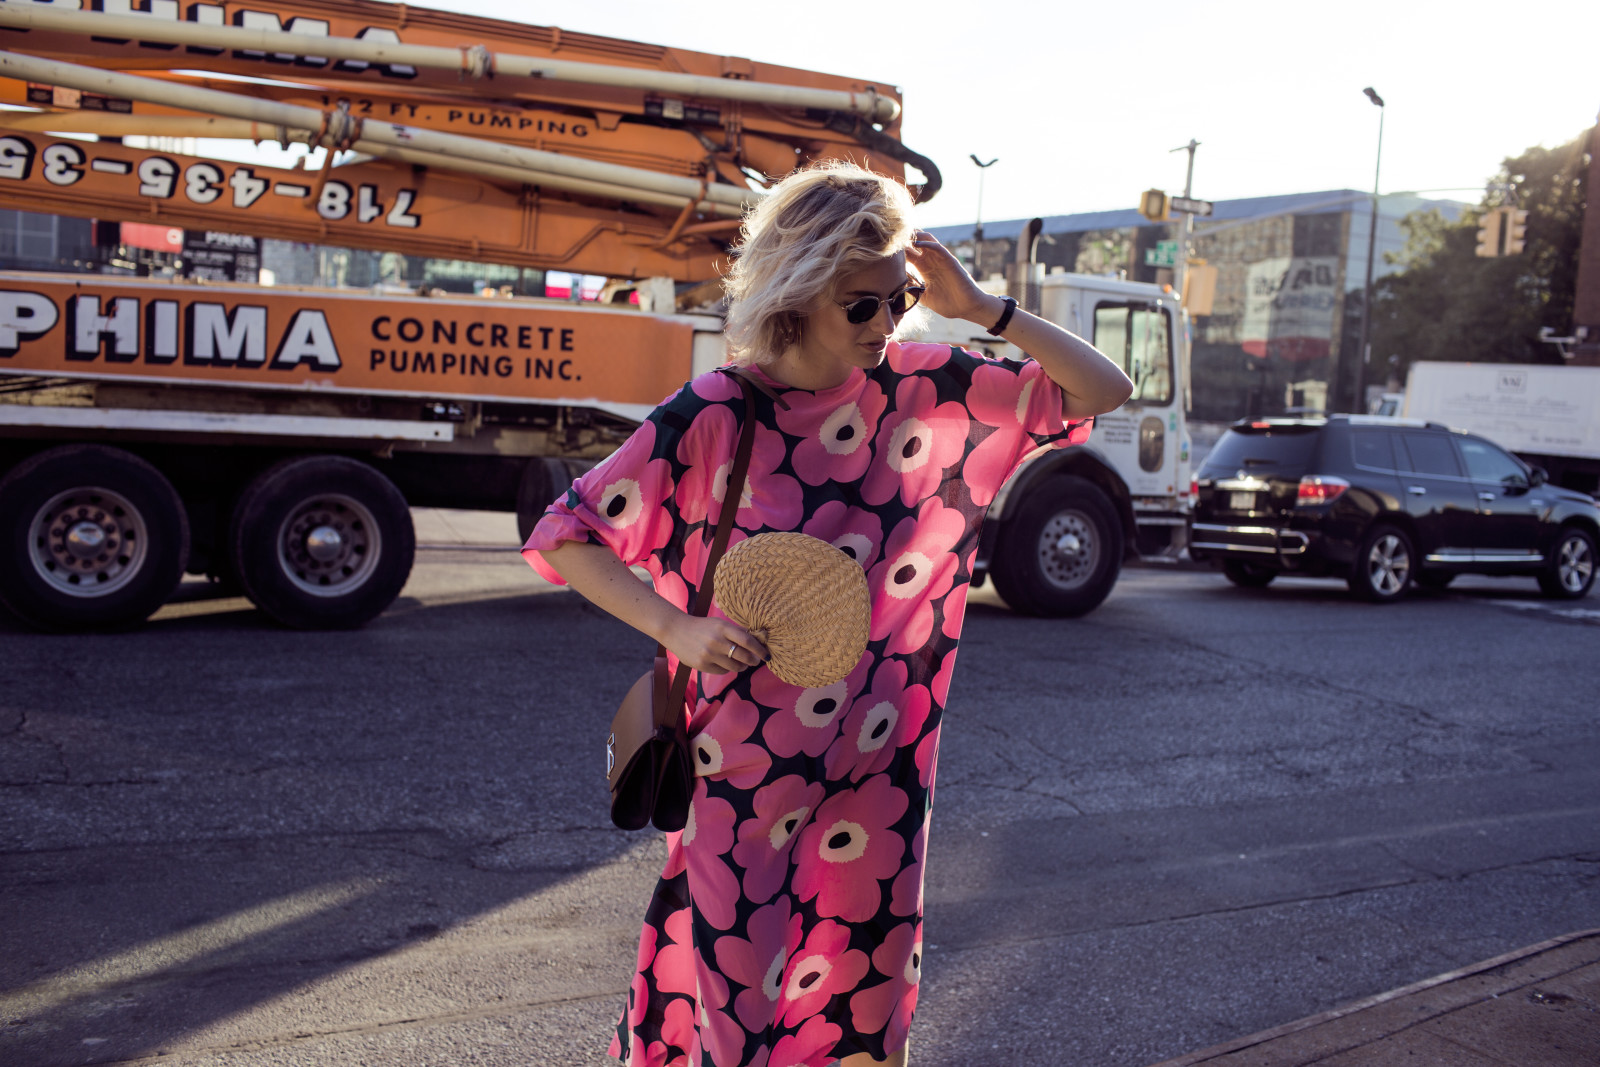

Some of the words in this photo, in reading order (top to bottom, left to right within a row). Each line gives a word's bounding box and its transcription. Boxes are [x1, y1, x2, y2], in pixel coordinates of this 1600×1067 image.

[389, 103, 432, 121] FT.
[448, 109, 589, 138] PUMPING
[0, 289, 342, 373] PHIMA
[371, 315, 575, 352] CONCRETE
[369, 349, 514, 378] PUMPING
[524, 357, 583, 382] INC.
